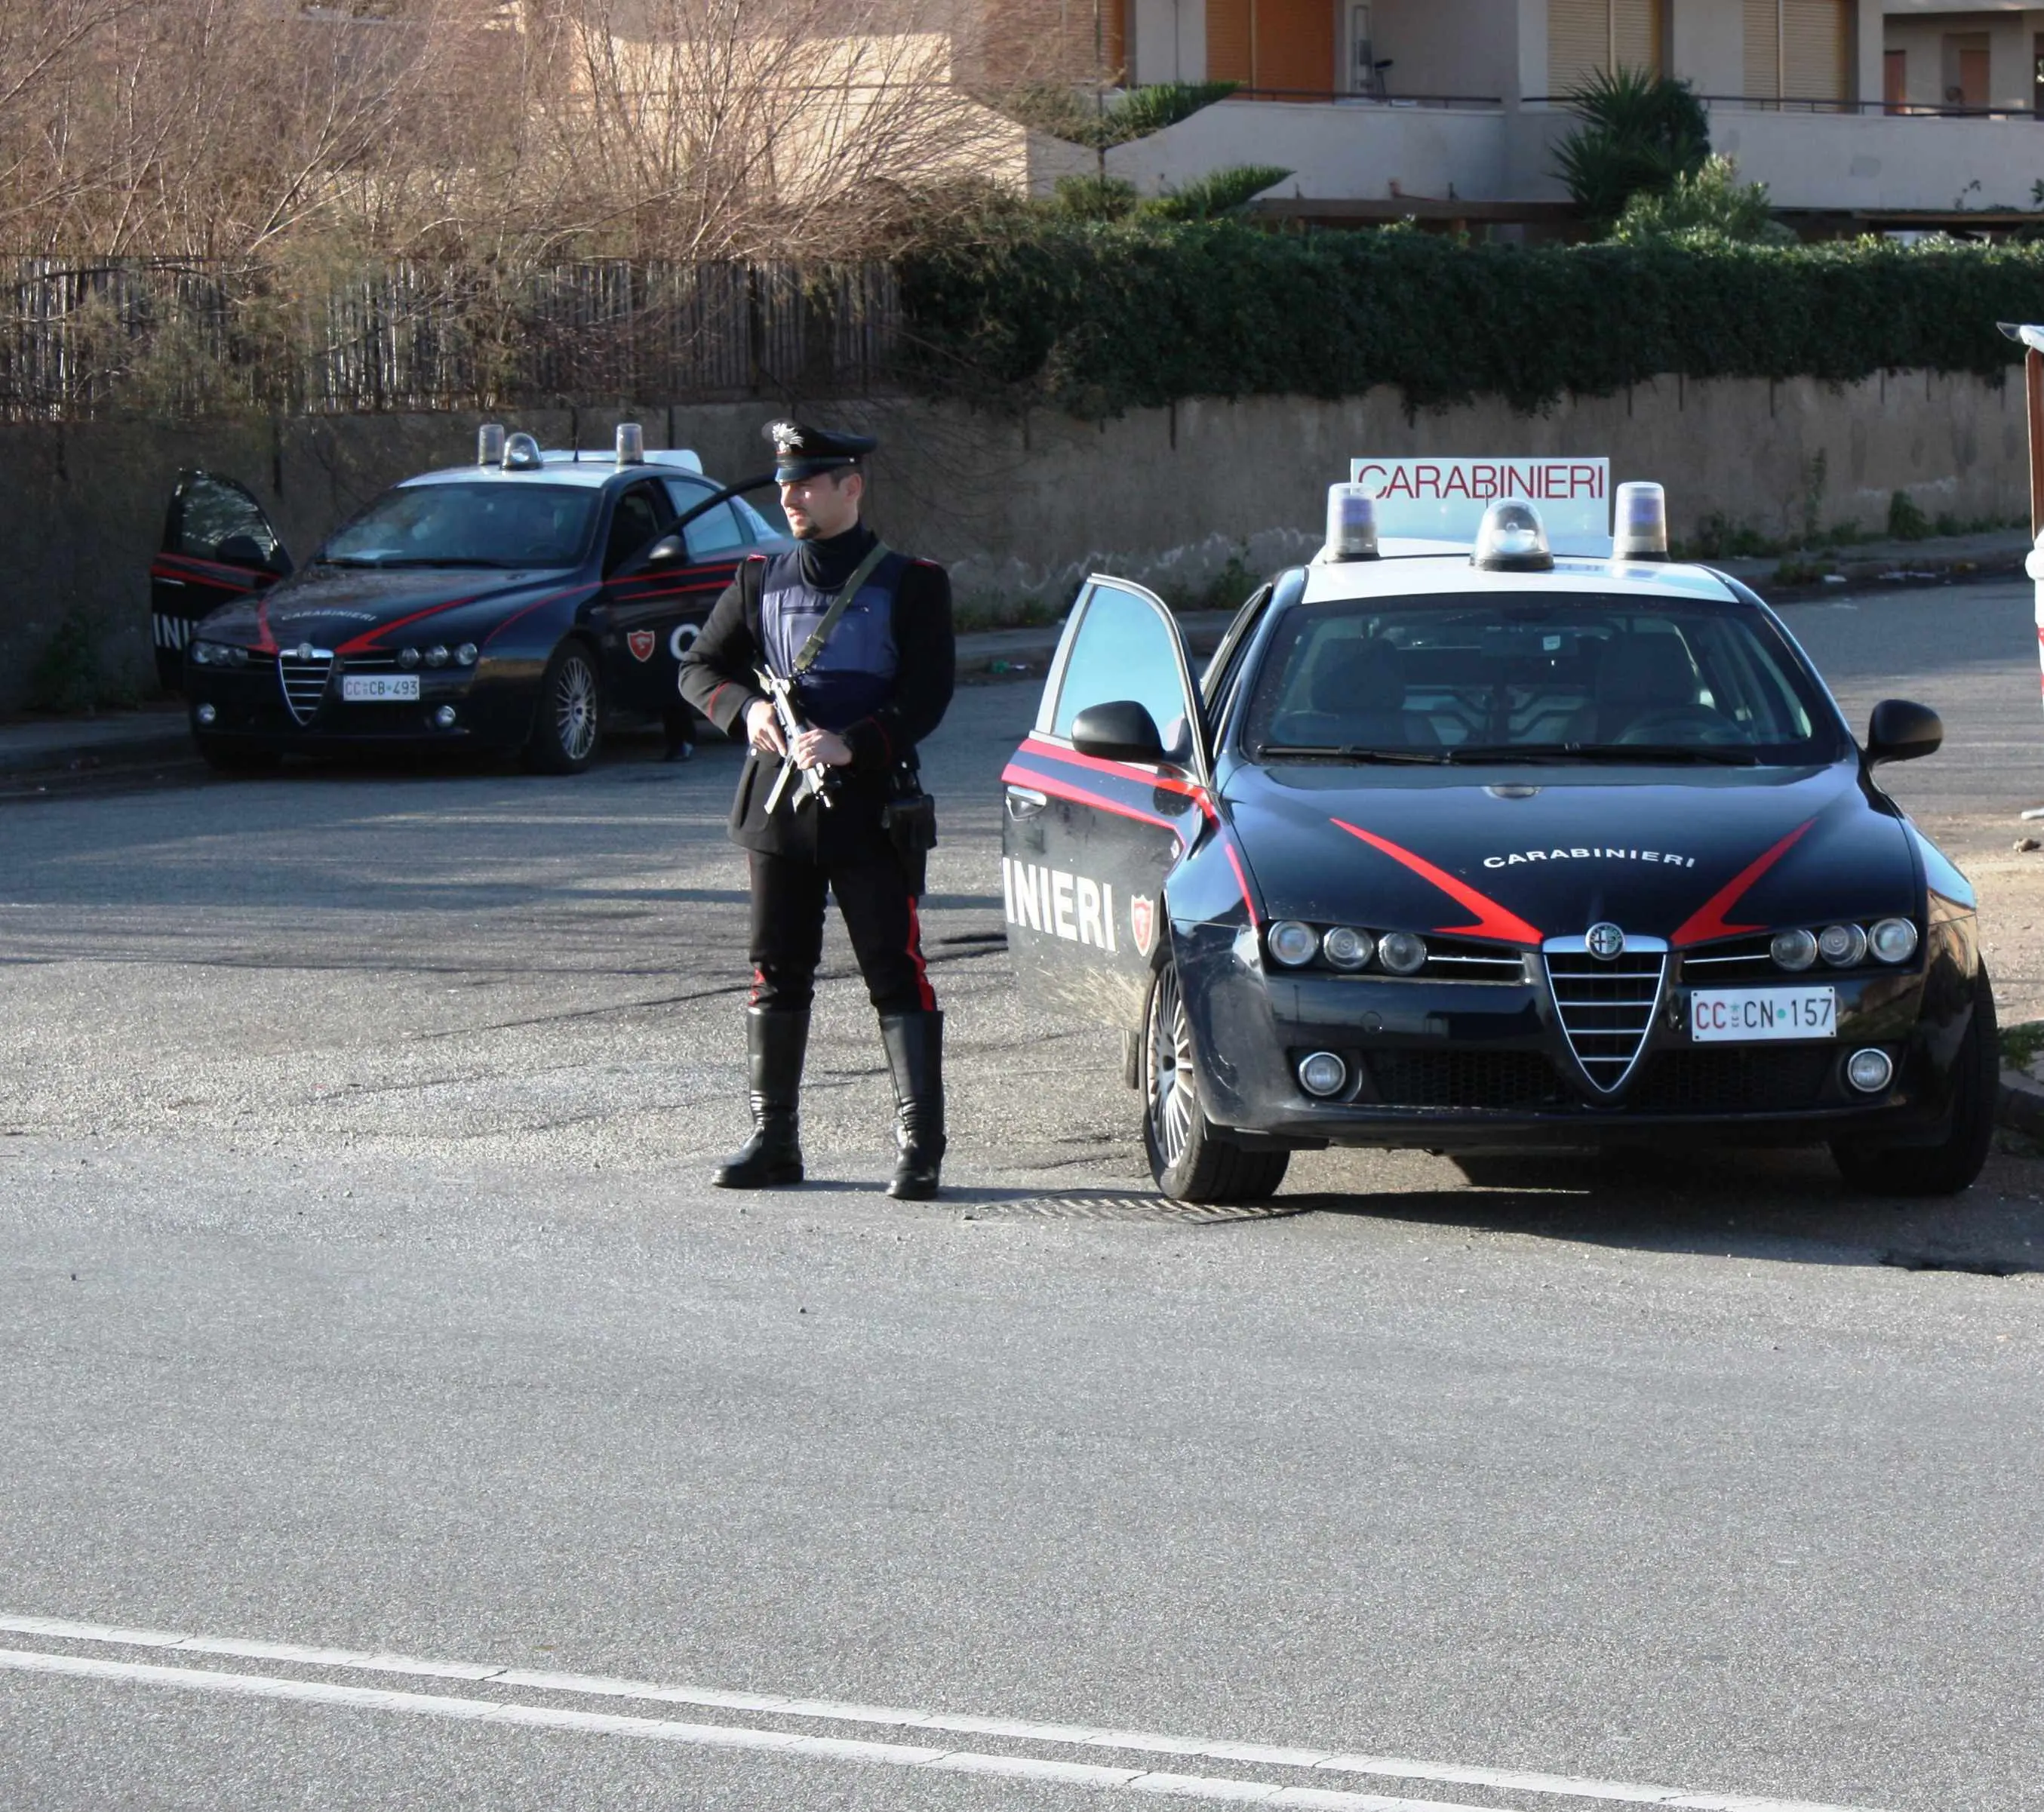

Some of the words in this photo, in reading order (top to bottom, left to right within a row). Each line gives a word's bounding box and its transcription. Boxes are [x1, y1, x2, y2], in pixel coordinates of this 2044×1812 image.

[1357, 465, 1604, 500] CARABINIERI
[281, 610, 377, 621] CARABINIERI
[345, 681, 361, 695] CC
[369, 681, 386, 695] CB
[393, 681, 417, 695] 493
[1483, 848, 1695, 869] CARABINIERI
[1002, 857, 1117, 952] INIERI
[1695, 1001, 1727, 1030] CC
[1744, 999, 1775, 1029] CN
[1790, 998, 1832, 1027] 157
